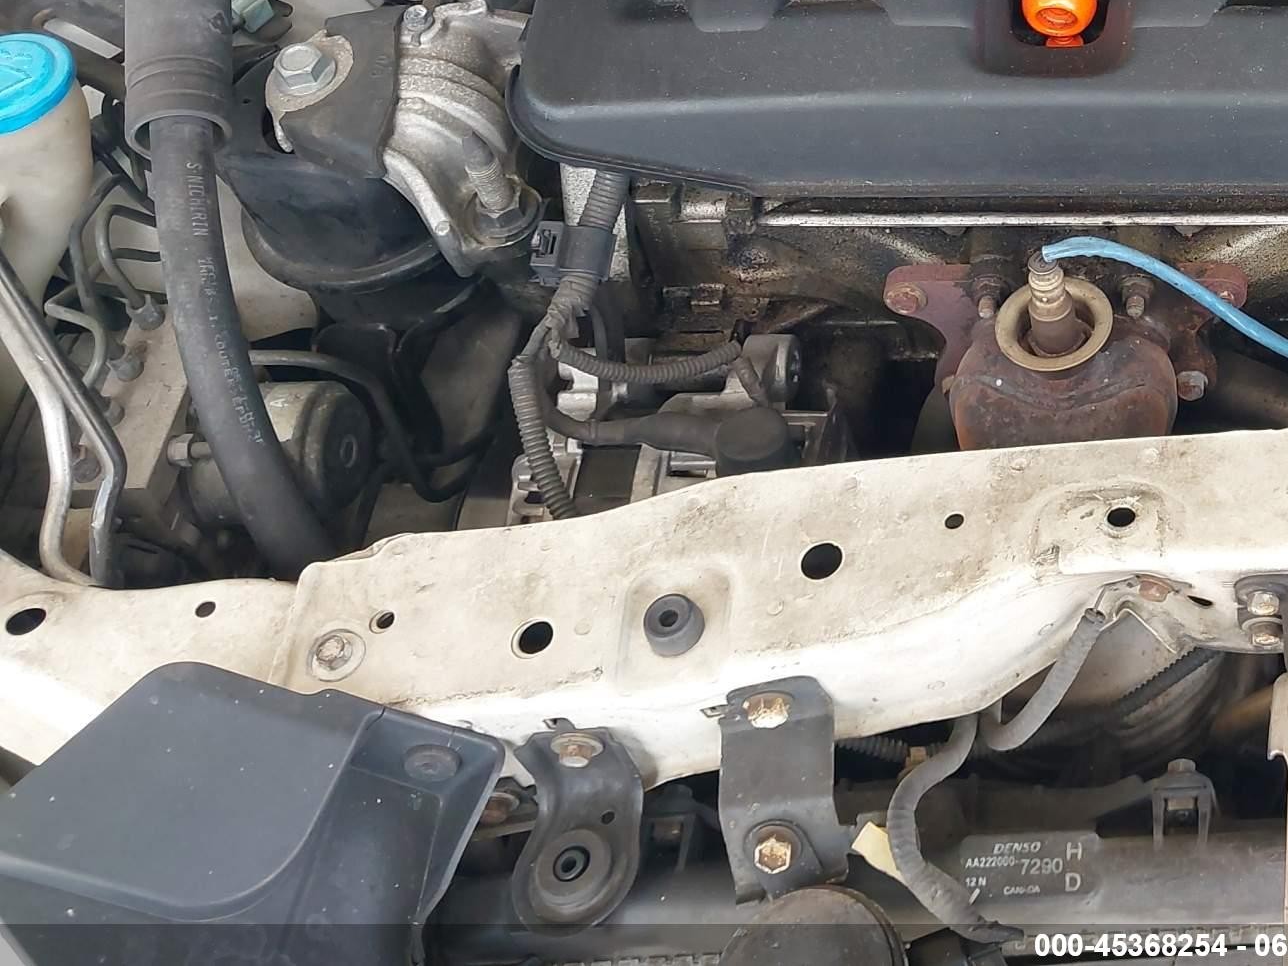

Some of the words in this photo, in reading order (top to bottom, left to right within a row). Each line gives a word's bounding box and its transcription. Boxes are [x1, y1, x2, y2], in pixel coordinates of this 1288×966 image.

[993, 842, 1041, 854] DENSO
[1066, 842, 1082, 861] H
[1064, 873, 1081, 892] D
